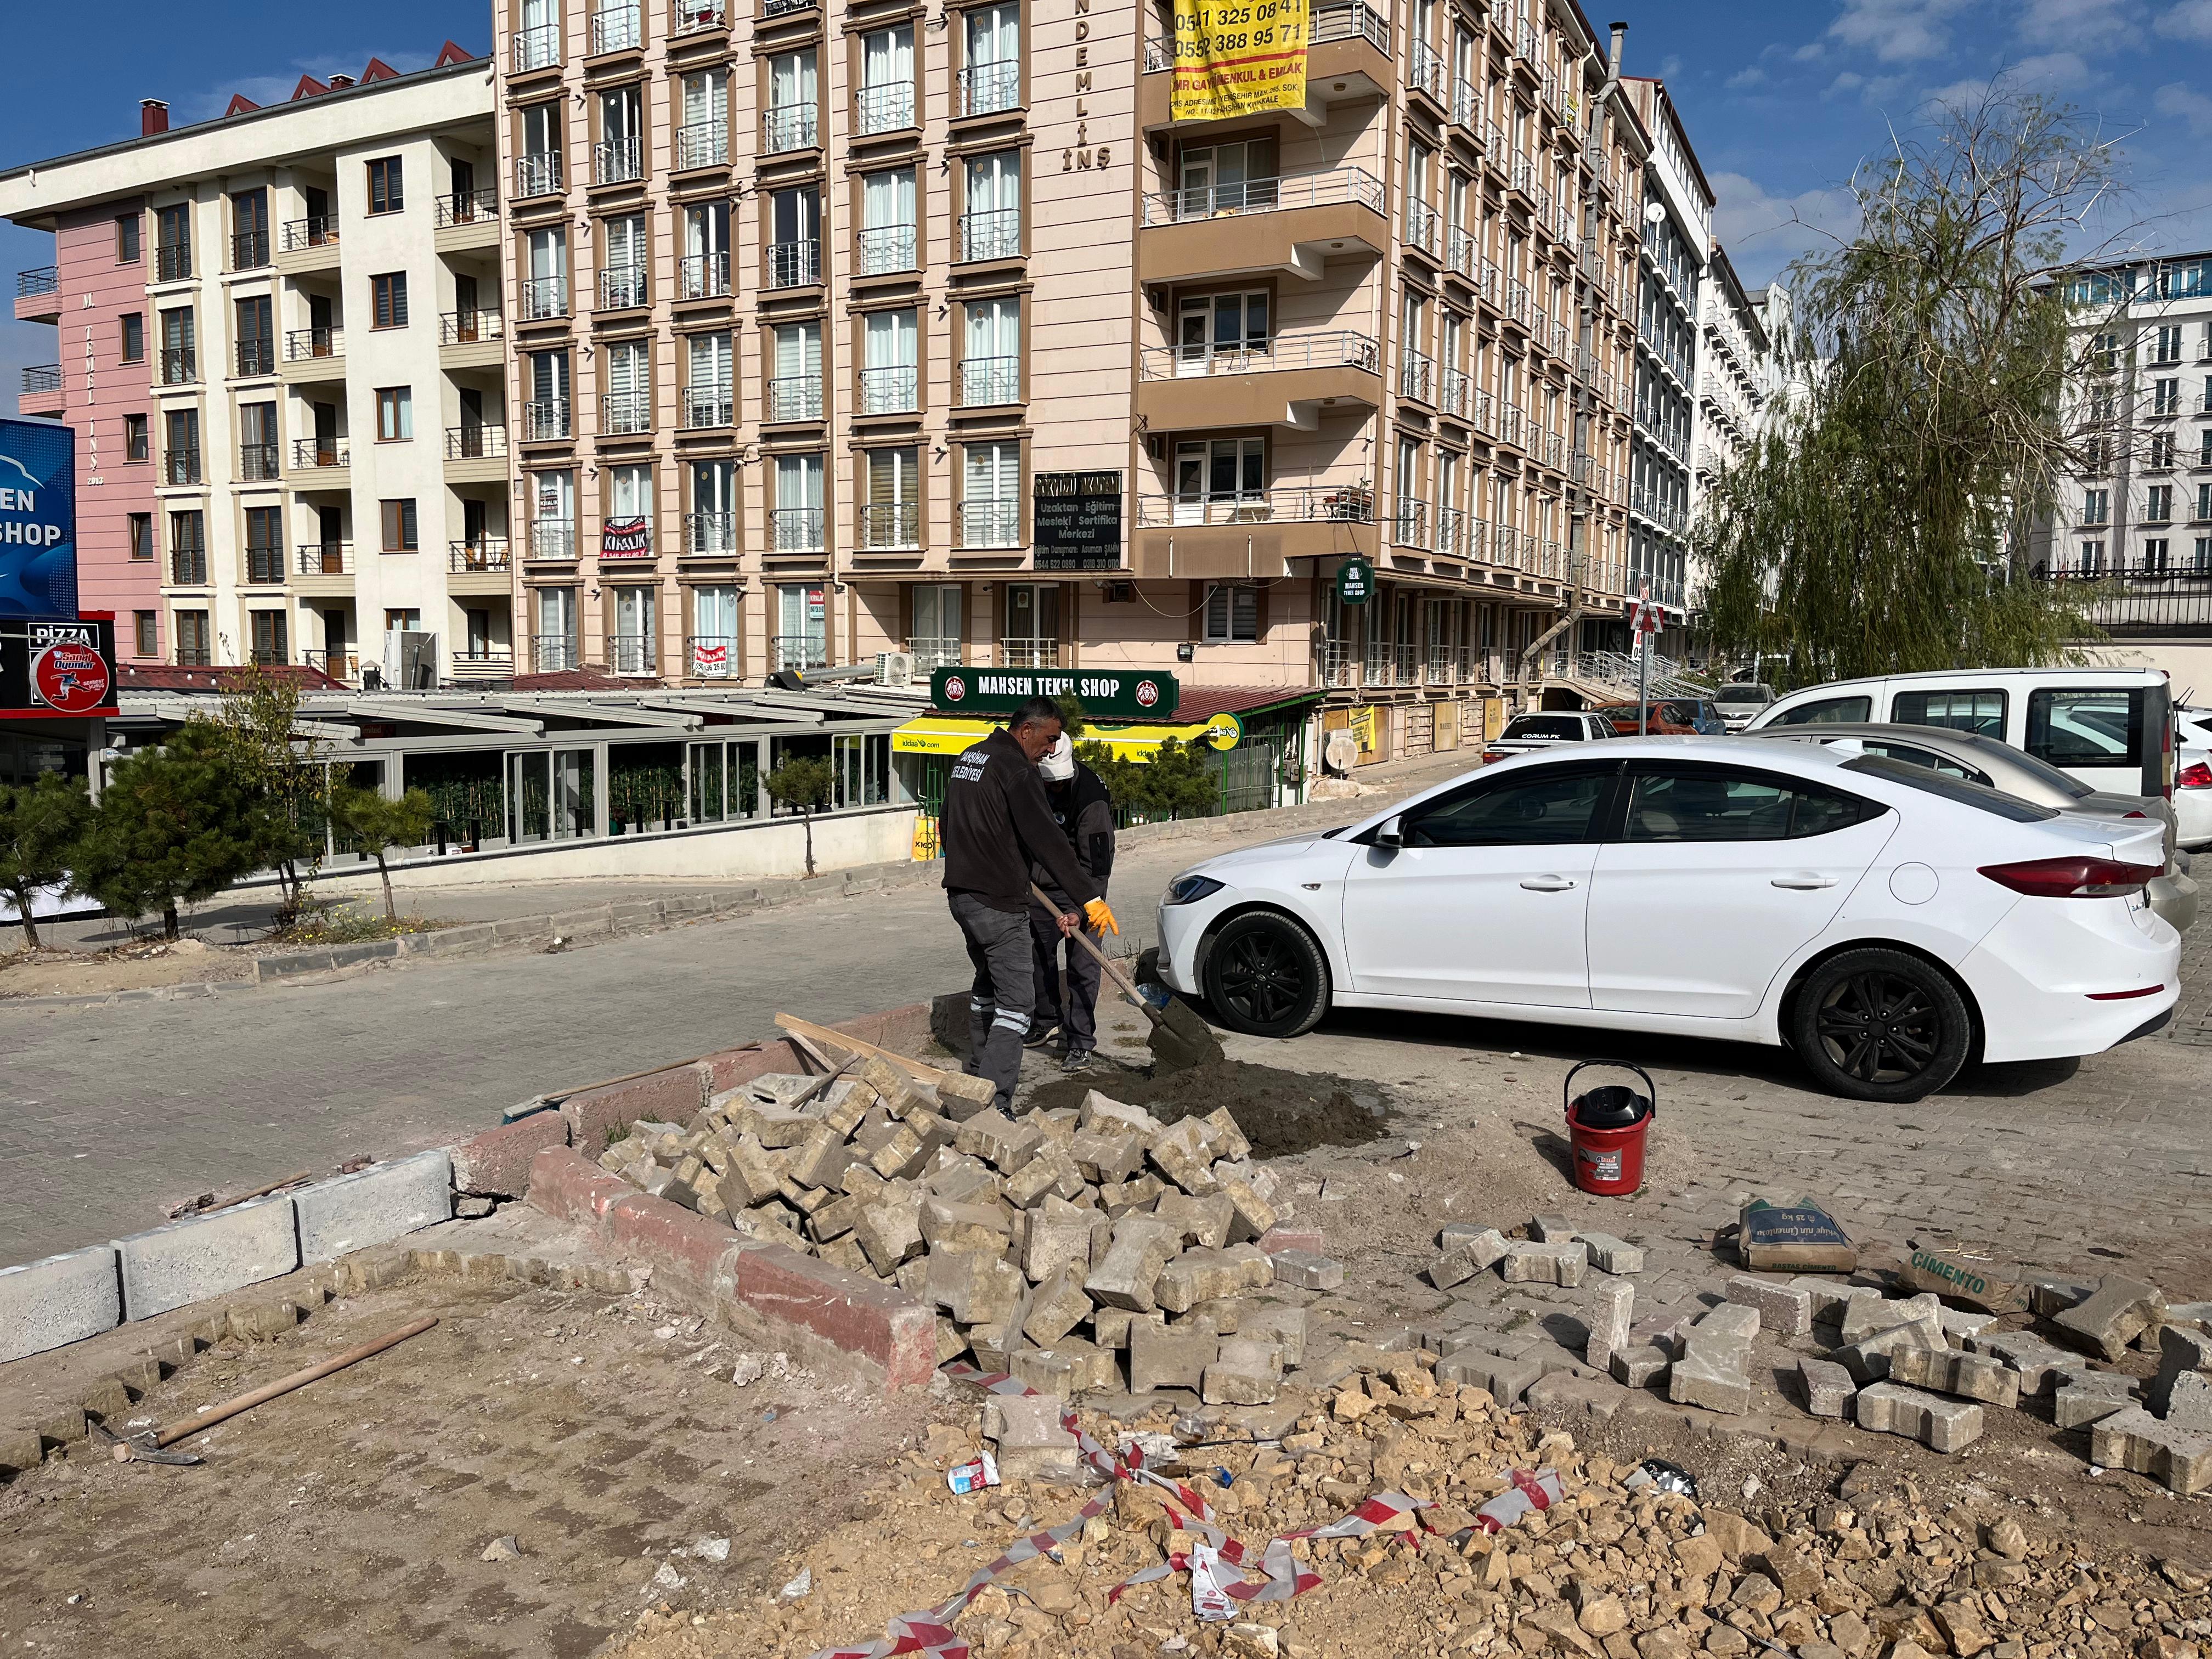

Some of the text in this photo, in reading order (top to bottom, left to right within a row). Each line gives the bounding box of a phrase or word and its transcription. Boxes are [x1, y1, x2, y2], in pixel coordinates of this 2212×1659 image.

[1176, 0, 1301, 32] 0541 325 08 41
[1176, 23, 1301, 58] 0552 388 95 71
[1259, 69, 1266, 80] &
[1269, 63, 1302, 80] EMLAK
[87, 476, 104, 486] 2013
[1040, 501, 1115, 514] Uzaktan Eğitim
[1037, 515, 1118, 527] Mesleki Sertifika
[0, 518, 61, 546] HOP
[1058, 528, 1095, 539] Merkezi
[605, 533, 645, 551] KIRALIK
[1638, 608, 1657, 618] PERNEL
[36, 625, 91, 644] PİZZA
[62, 652, 92, 662] Sanal
[54, 661, 96, 670] Oyunlar
[978, 676, 1120, 697] MAHSEN TEKEL SHOP
[1781, 1212, 1793, 1221] kg
[1911, 1252, 1985, 1294] ÇİMENTO
